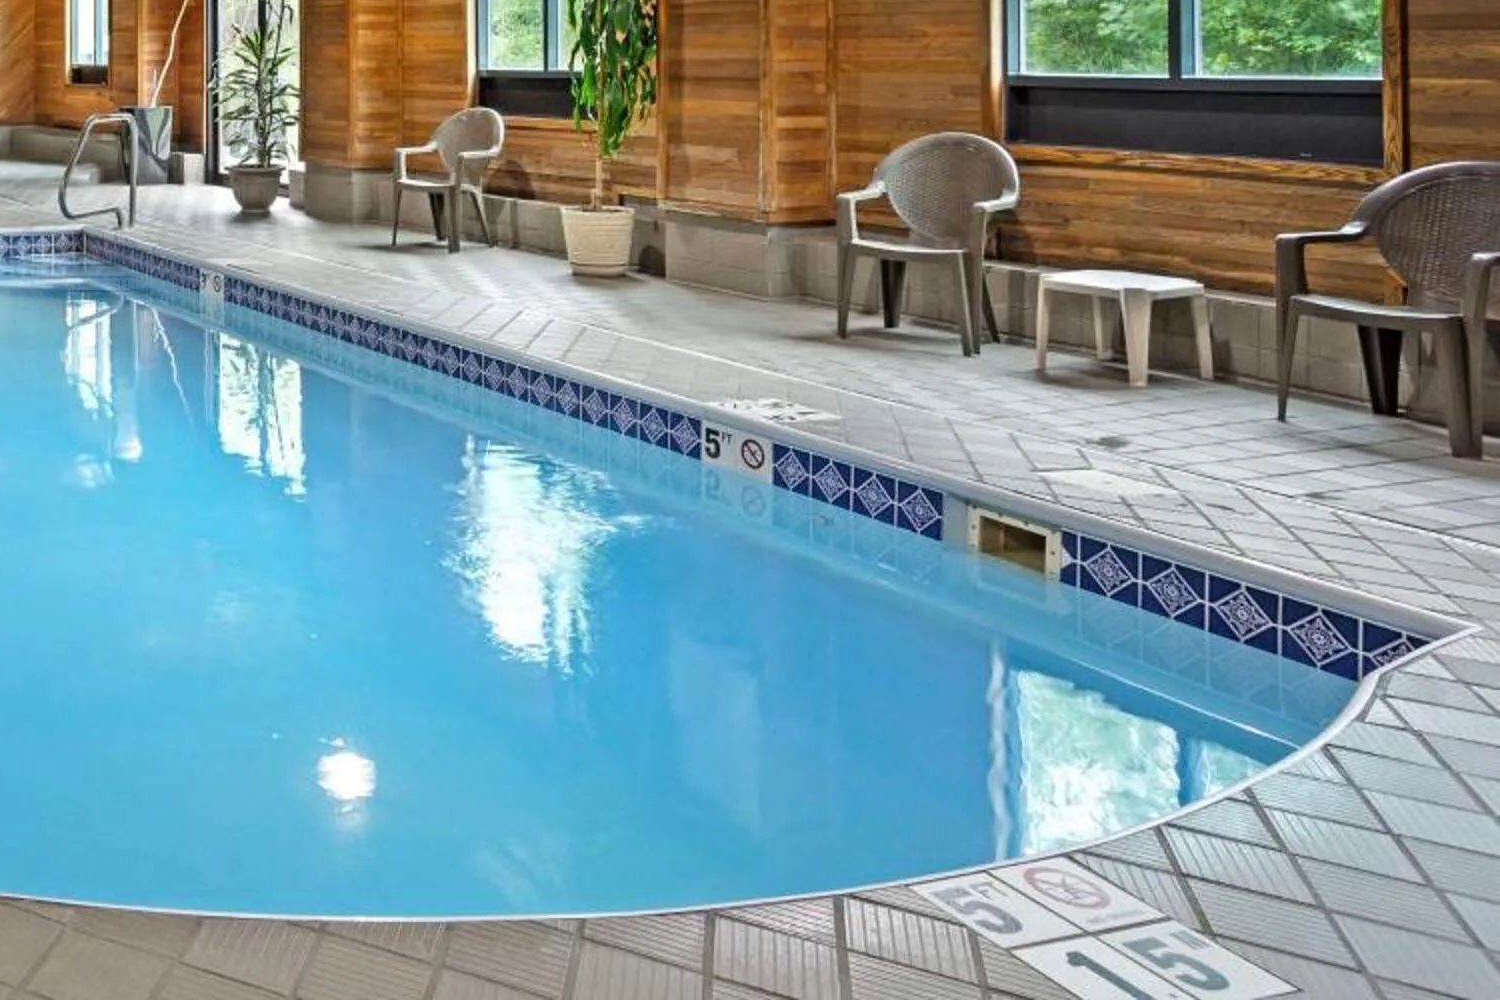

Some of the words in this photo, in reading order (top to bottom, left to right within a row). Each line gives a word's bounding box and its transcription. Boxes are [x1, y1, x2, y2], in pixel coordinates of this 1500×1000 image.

[705, 426, 721, 459] 5
[721, 431, 732, 444] FT
[932, 888, 1023, 934] 5
